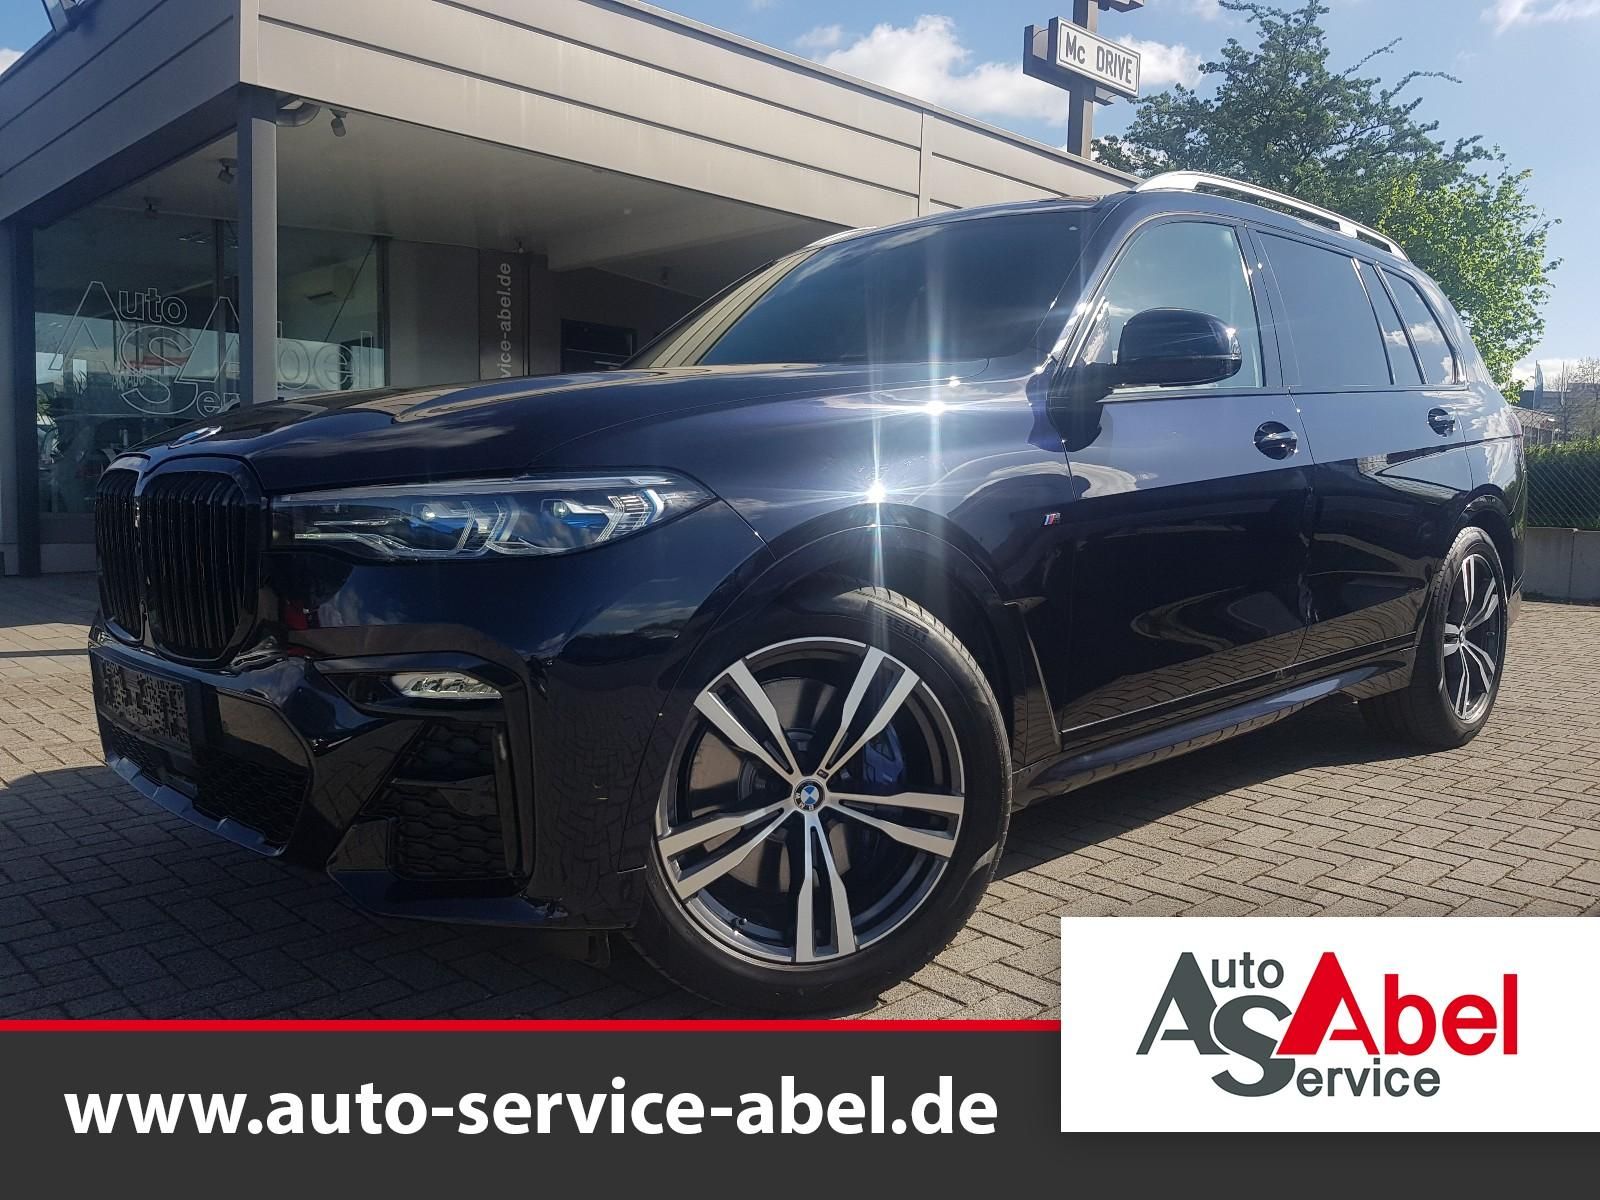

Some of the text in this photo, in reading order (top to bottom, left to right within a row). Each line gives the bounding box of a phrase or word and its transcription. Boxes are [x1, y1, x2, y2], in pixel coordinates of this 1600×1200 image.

[1065, 32, 1133, 84] Mc DRIVE
[48, 281, 188, 371] Auto
[497, 263, 512, 378] vice-abel.de
